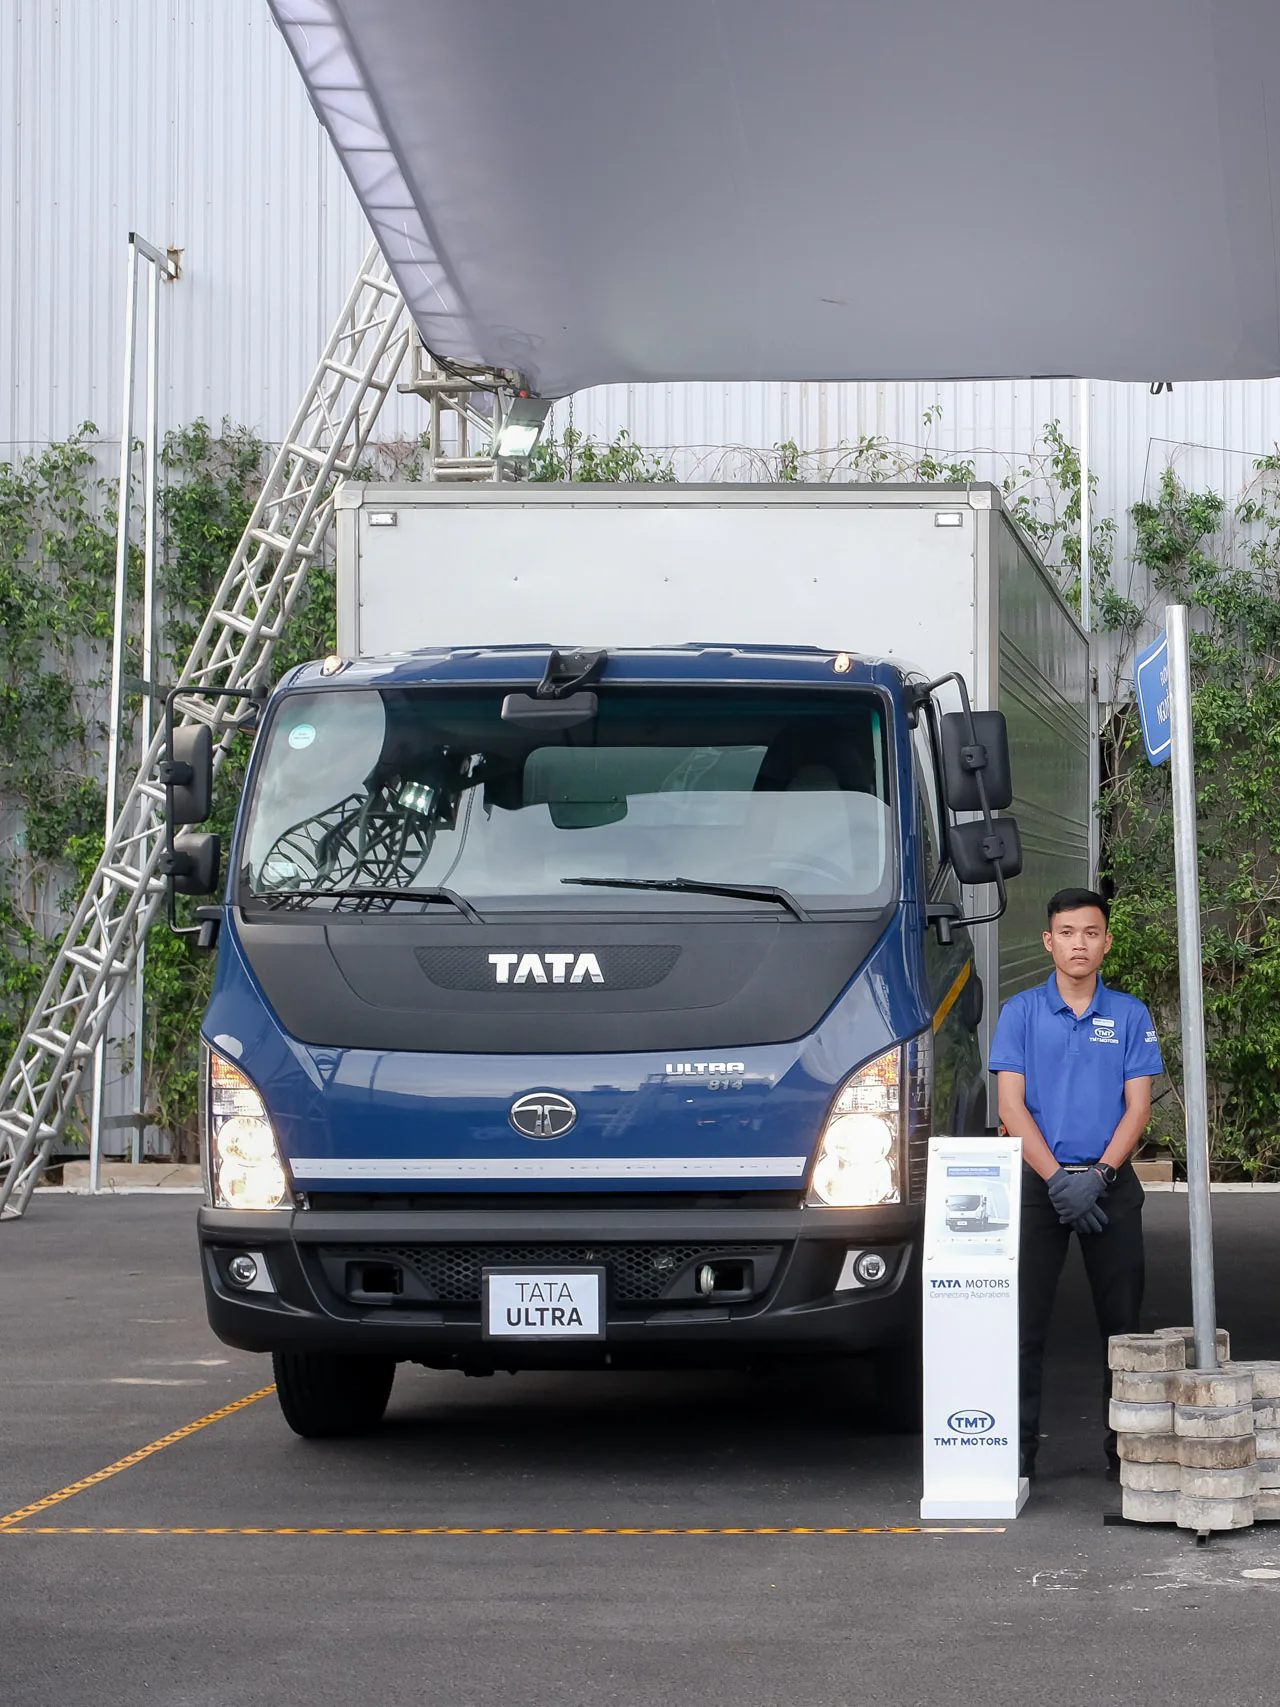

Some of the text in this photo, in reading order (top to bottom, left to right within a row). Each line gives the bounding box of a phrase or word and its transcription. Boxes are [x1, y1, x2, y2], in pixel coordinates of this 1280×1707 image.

[488, 953, 605, 984] TATA
[665, 1062, 745, 1076] ULTRA
[707, 1079, 744, 1091] 814
[929, 1279, 1010, 1289] TATA MOTORS
[514, 1282, 574, 1303] TATA
[929, 1291, 1010, 1300] Connecting Aspirations
[506, 1307, 583, 1327] ULTRA
[954, 1417, 988, 1428] TMT
[933, 1437, 1008, 1446] TMT MOTORS
